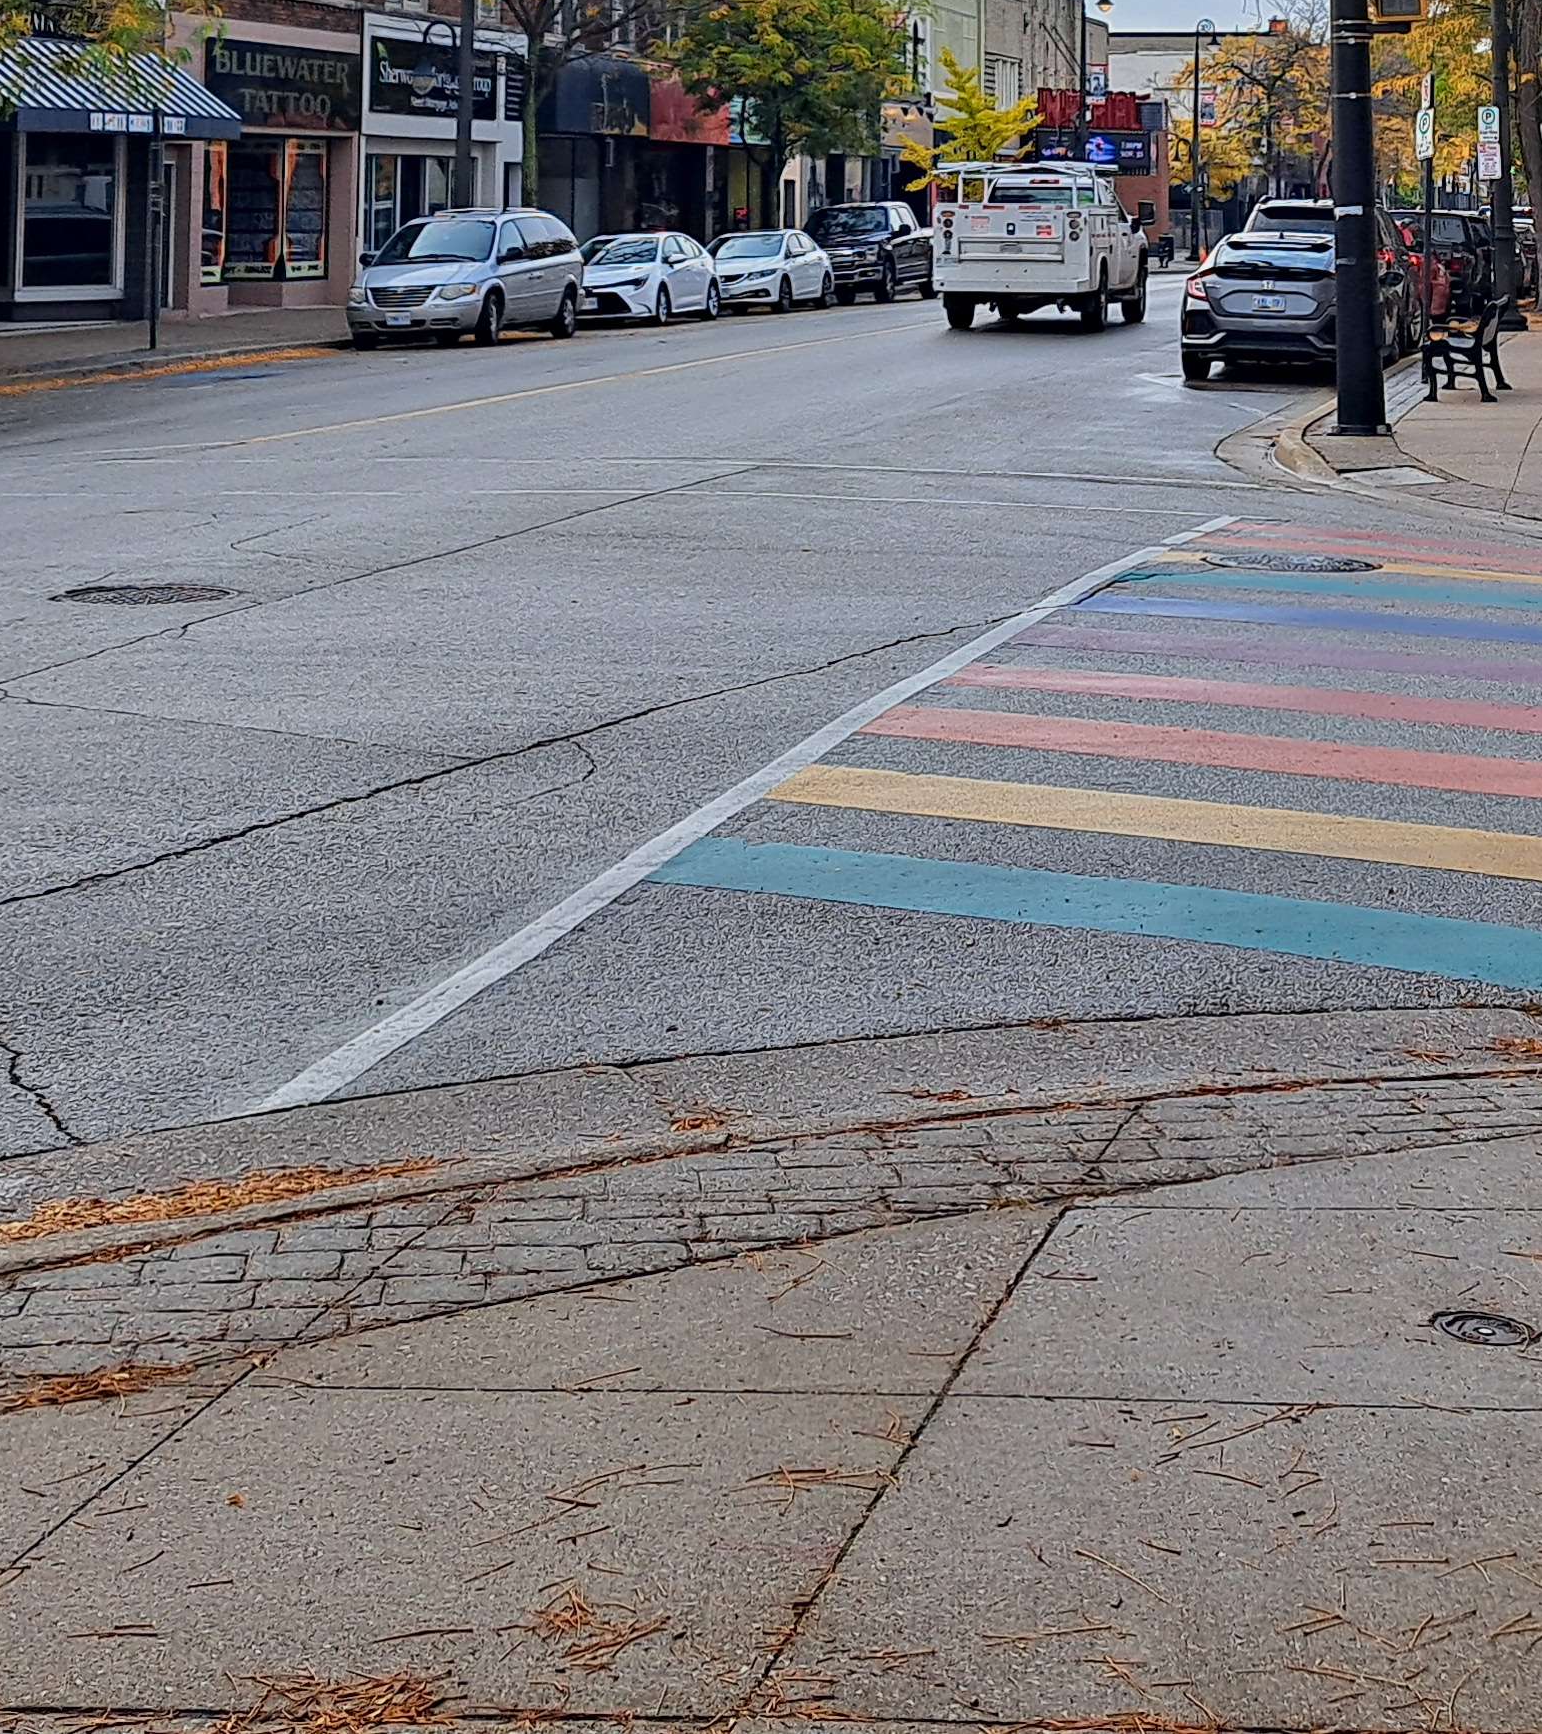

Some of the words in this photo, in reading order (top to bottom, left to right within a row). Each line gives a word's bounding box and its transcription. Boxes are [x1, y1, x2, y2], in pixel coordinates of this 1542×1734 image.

[214, 49, 349, 84] BLUEWATER
[379, 60, 414, 84] Sherwo
[473, 76, 492, 98] roup
[239, 88, 332, 116] TATTOO
[1485, 112, 1492, 120] P
